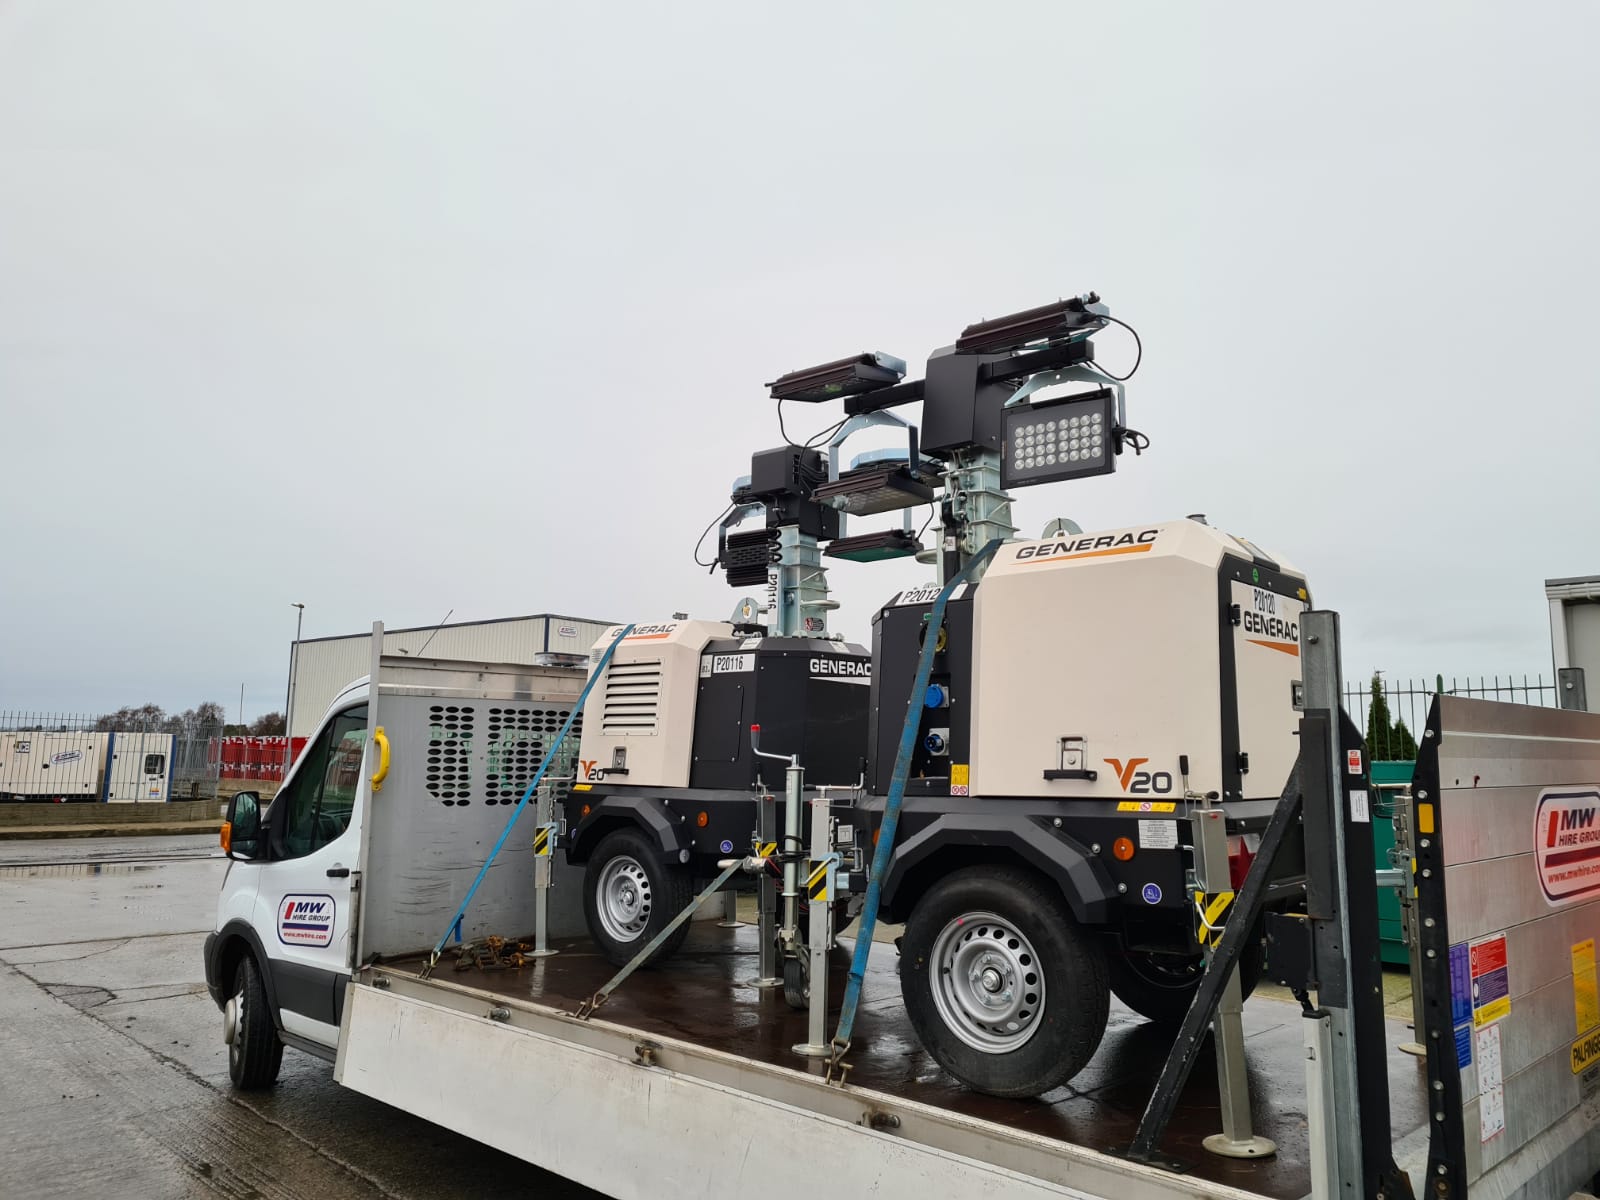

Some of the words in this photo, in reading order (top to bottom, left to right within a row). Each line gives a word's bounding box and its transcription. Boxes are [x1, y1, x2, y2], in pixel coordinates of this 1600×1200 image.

[1015, 529, 1159, 559] GENERAC
[903, 588, 941, 602] P2012
[1253, 588, 1276, 615] P20120
[611, 623, 677, 638] GNERAC
[1243, 610, 1299, 642] GENERAC
[716, 655, 744, 671] P20116
[809, 658, 872, 676] GENERAC
[1560, 807, 1596, 831] MW
[1558, 832, 1578, 847] HIRE
[1548, 864, 1600, 884] www.mwhire.co
[295, 902, 326, 913] MW
